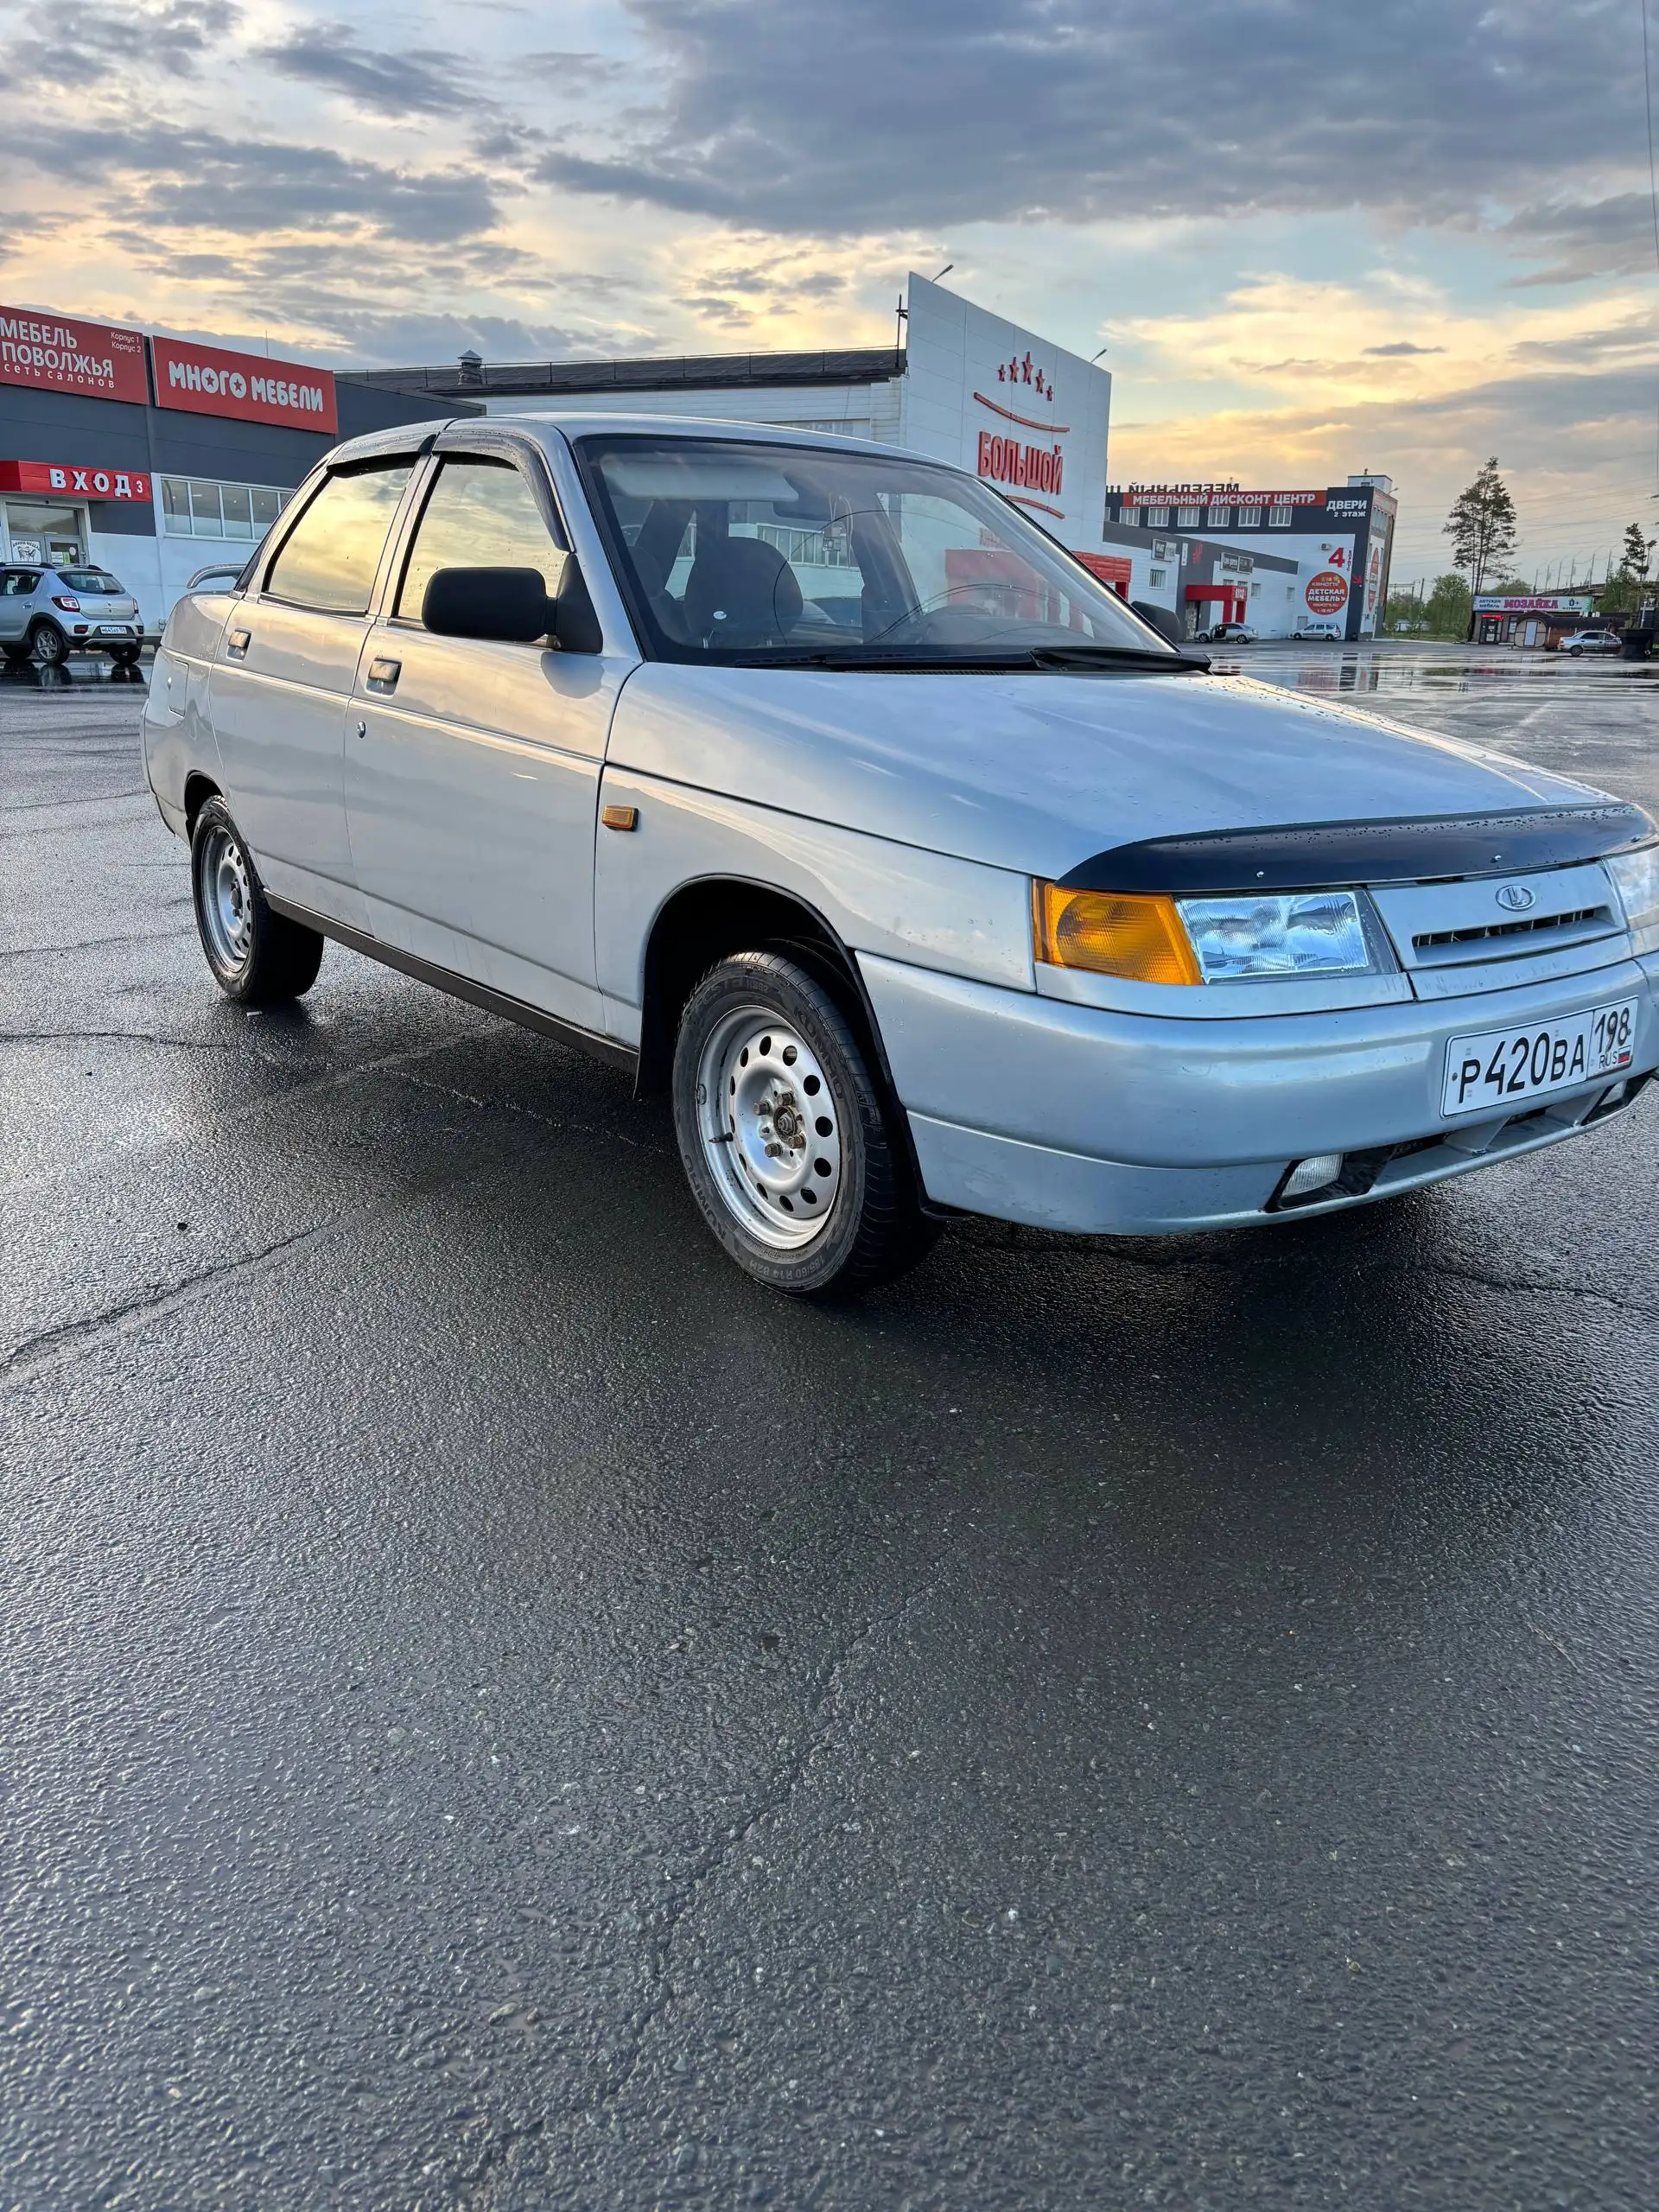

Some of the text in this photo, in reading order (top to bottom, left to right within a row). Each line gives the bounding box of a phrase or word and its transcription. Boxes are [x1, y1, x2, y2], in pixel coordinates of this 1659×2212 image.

[0, 317, 77, 349] МЕБЕЛЬ
[111, 331, 135, 344] Корпус
[2, 341, 114, 378] ПОВОЛЖЬЯ
[111, 341, 136, 353] Корпус
[4, 364, 115, 389] сеть салонов
[168, 360, 324, 413] МНОГО МЕБЕЛИ
[978, 430, 1064, 496] БОЛЬШОЙ
[49, 468, 143, 499] ВХОД 3
[1133, 493, 1316, 506] МЕБЕЛЬНЫЙ ДИСКОНТ ЦЕНТР
[1326, 499, 1368, 512] ДВЕРИ
[1328, 547, 1345, 568] 4
[1459, 1007, 1630, 1103] Р420ВА 198
[1599, 1051, 1618, 1069] RUS
